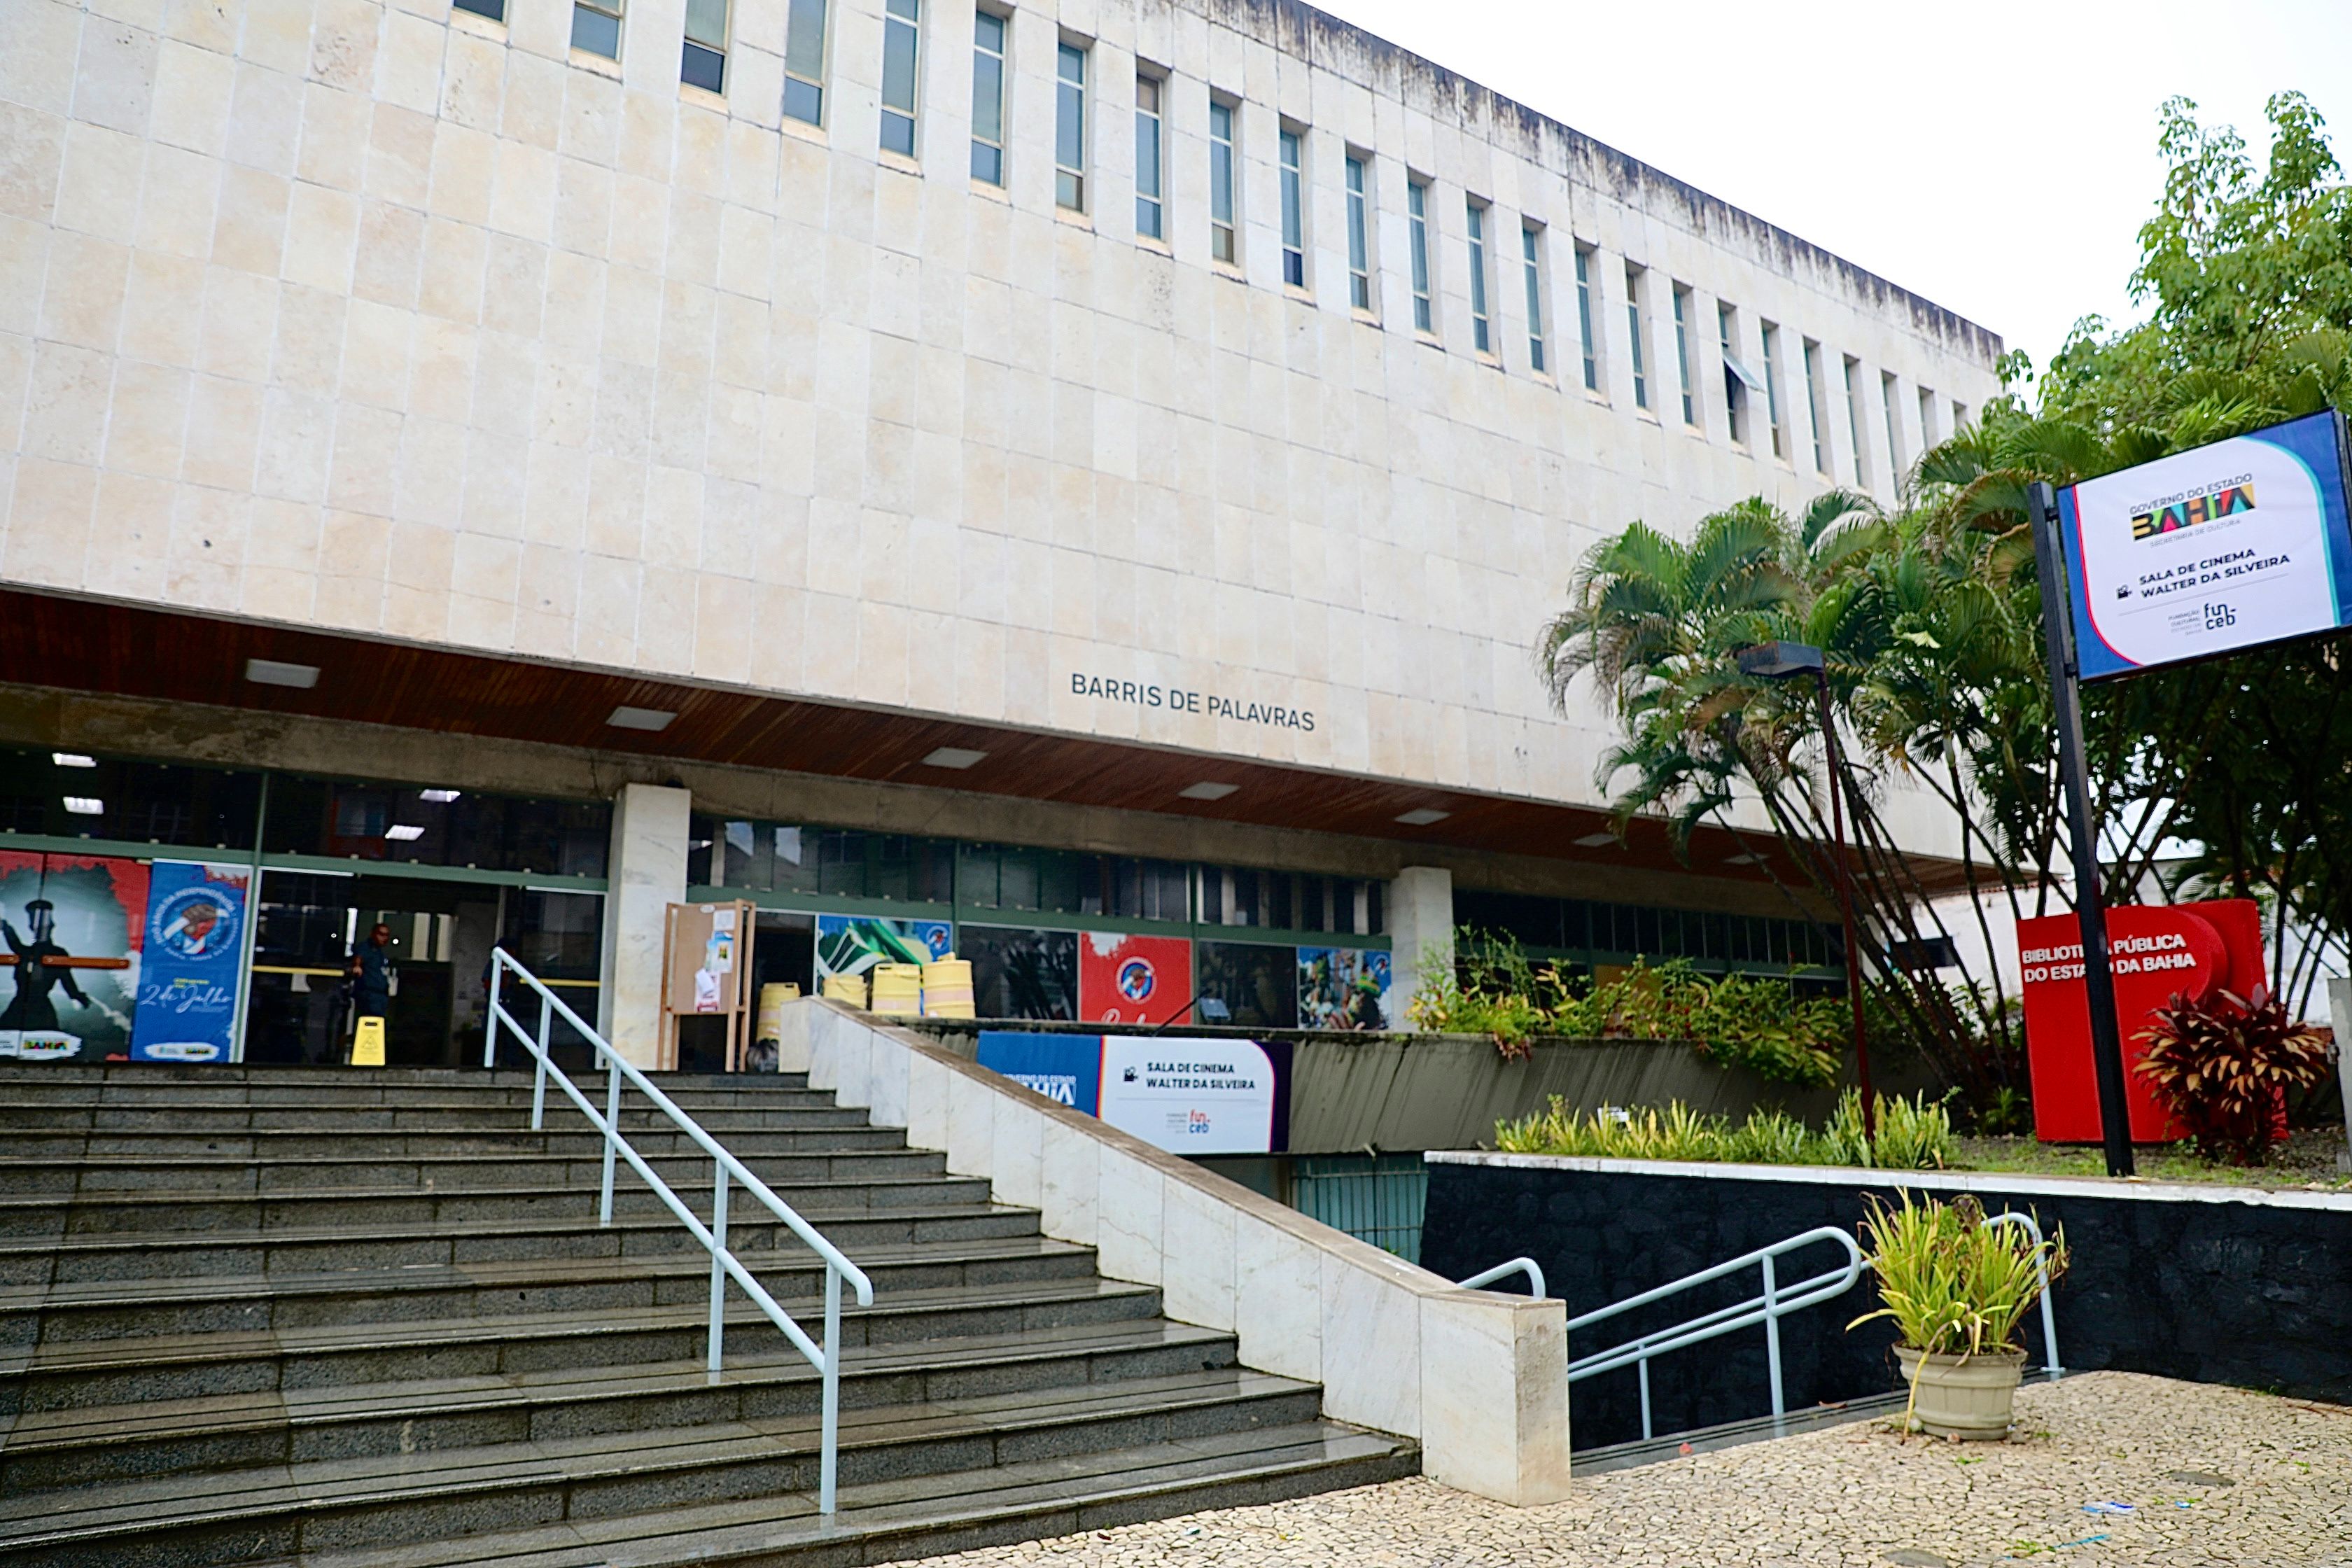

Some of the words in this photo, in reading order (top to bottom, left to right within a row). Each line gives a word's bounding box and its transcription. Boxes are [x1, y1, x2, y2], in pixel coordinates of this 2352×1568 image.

[2129, 493, 2184, 514] GOVERNO
[2187, 487, 2204, 499] DO
[2207, 473, 2252, 493] ESTADO
[2139, 570, 2174, 585] SALA
[2177, 564, 2196, 575] DE
[2200, 549, 2255, 570] CINEMA
[2141, 578, 2196, 598] WALTER
[2201, 572, 2221, 584] DA
[2224, 554, 2290, 578] SILVEIRA
[1072, 673, 1162, 708] BARRIS
[1170, 690, 1200, 713] DE
[1208, 696, 1315, 732] PALAVRAS
[2113, 933, 2187, 954] PÚBLICA
[2024, 967, 2047, 983] DO
[2050, 962, 2114, 980] ESTA
[2116, 958, 2141, 974] DA
[2143, 953, 2197, 972] BAHIA
[1146, 1079, 1190, 1088] WALTER
[1193, 1079, 1208, 1088] DA
[1210, 1080, 1256, 1090] SILVEIRA
[1147, 1062, 1175, 1072] SALA
[1177, 1063, 1190, 1072] DE
[1193, 1063, 1235, 1074] CINEMA
